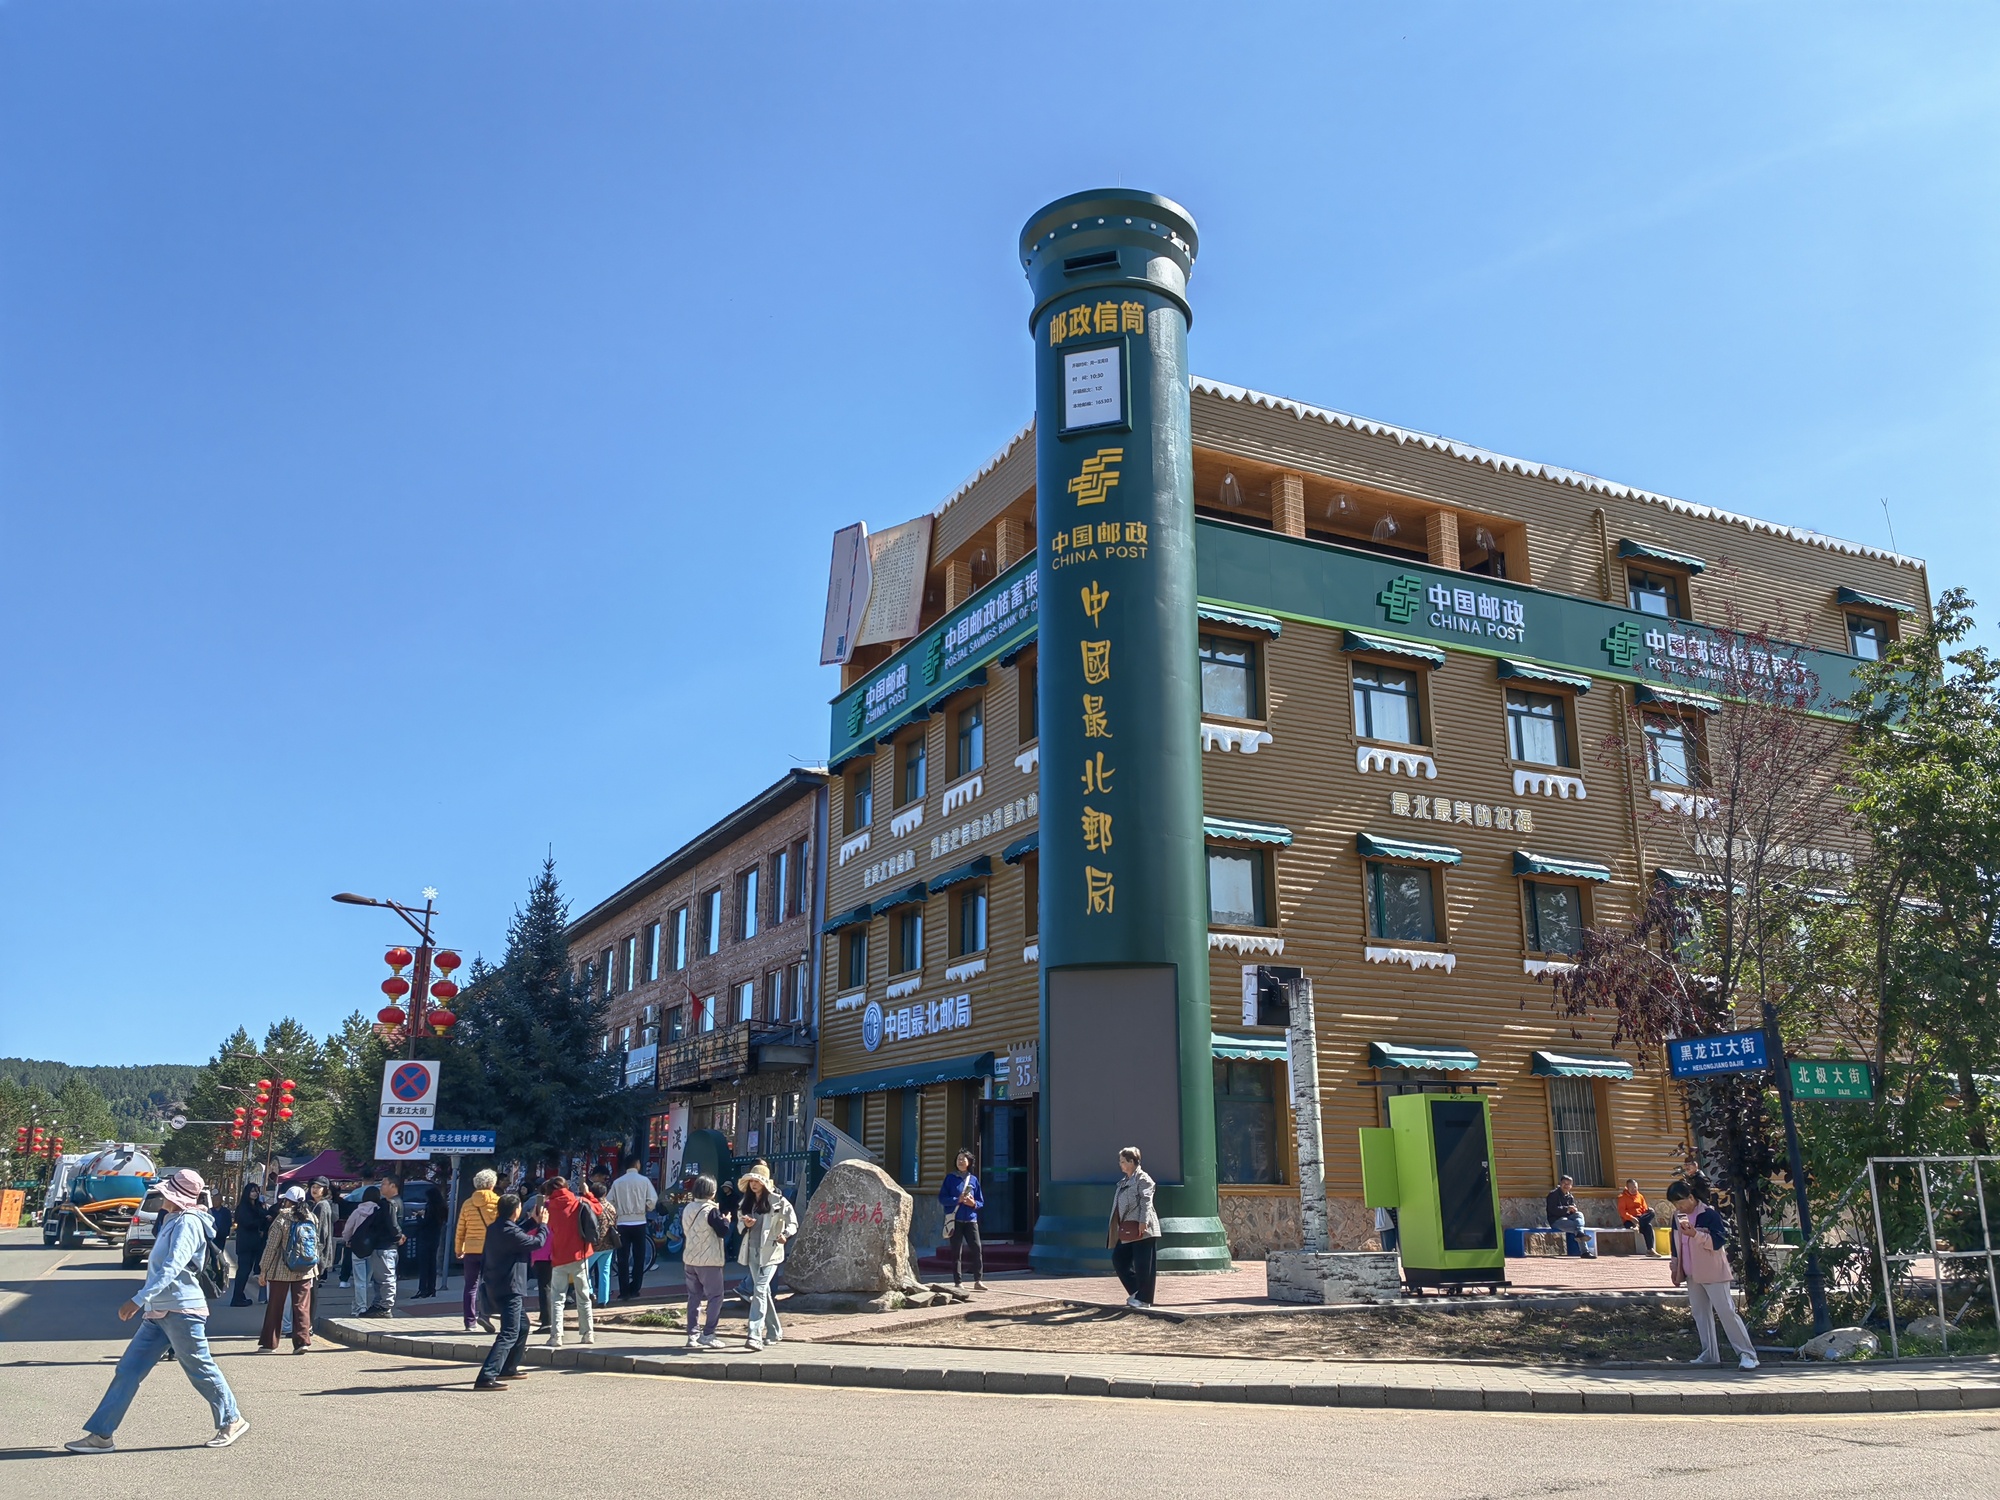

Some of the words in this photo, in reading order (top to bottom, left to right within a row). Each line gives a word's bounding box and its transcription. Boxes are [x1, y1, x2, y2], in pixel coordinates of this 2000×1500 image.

[1050, 300, 1145, 347] 邮政信筒
[1090, 372, 1104, 380] 10:30
[1052, 521, 1148, 554] 中国邮政
[1052, 548, 1098, 570] CHINA
[1105, 545, 1148, 559] POST
[1428, 583, 1525, 628] 中国邮政
[944, 646, 968, 670] POSTAL
[969, 626, 998, 653] SAVINGS
[998, 612, 1018, 634] BANK
[1019, 604, 1030, 620] OF
[1430, 612, 1481, 635] CHINA
[1487, 622, 1525, 643] POST
[866, 662, 909, 710] 中国邮政
[865, 706, 887, 725] CHINA
[888, 687, 907, 706] POST
[1390, 791, 1533, 833] 最北最美的祝福
[885, 993, 972, 1042] 中国最北邮局
[1680, 1037, 1755, 1061] 黑龙江大街
[1016, 1064, 1031, 1087] 35
[1692, 1061, 1729, 1071] HEILONGJIANG
[1729, 1059, 1745, 1068] DAJIE
[1798, 1066, 1860, 1084] 北极大街
[1813, 1087, 1826, 1095] BEIJI
[1838, 1088, 1851, 1096] DAJIE
[387, 1106, 427, 1115] 黑龙江大街
[393, 1130, 414, 1146] 30
[429, 1133, 487, 1143] 我在北极村等你
